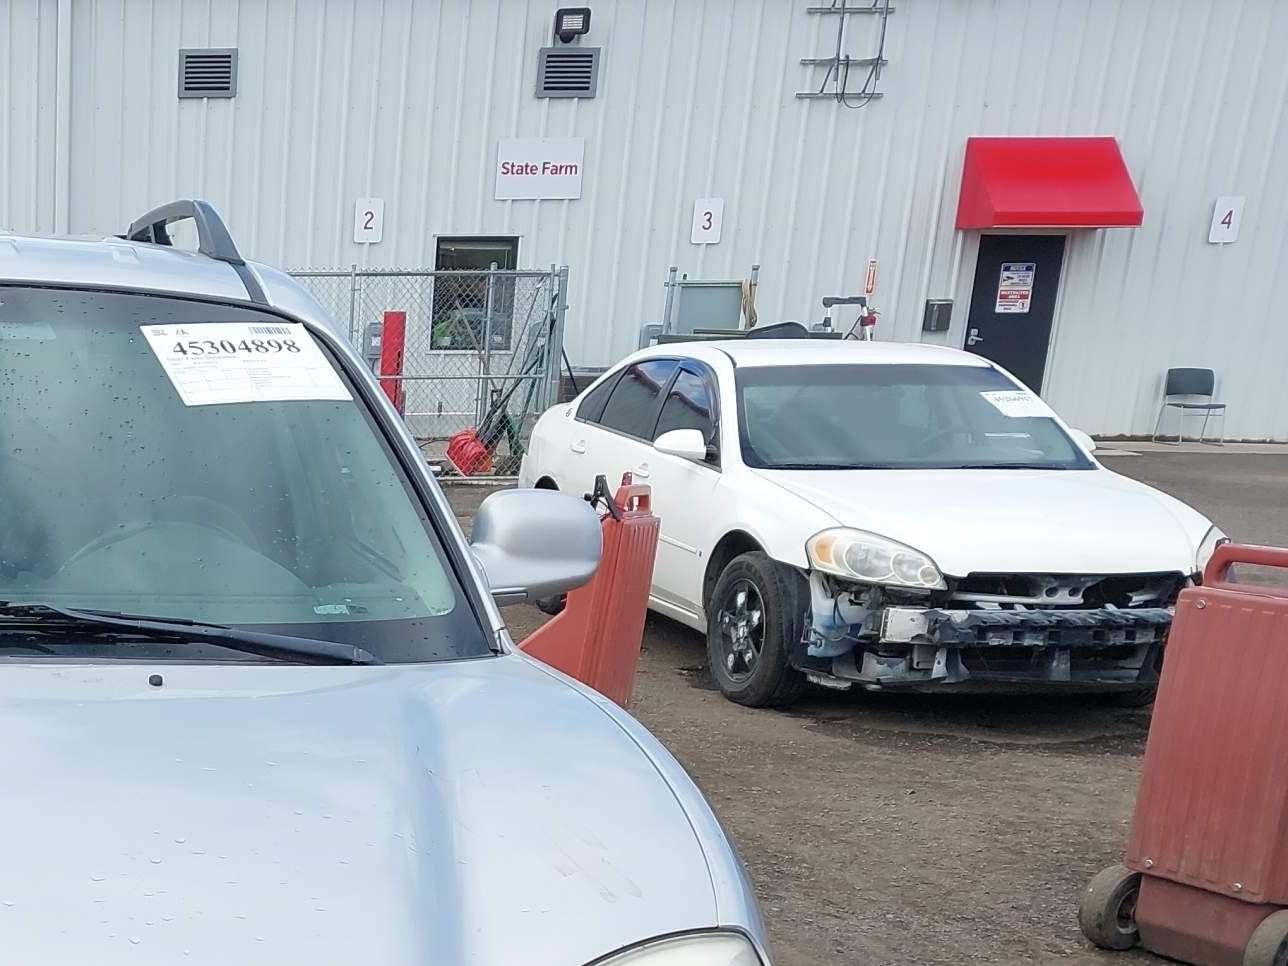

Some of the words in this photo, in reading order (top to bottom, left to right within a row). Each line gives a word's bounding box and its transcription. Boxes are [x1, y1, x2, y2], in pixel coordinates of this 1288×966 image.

[501, 161, 539, 176] State
[542, 161, 579, 176] Farm
[363, 211, 375, 230] 2
[702, 211, 714, 230] 3
[1220, 209, 1234, 230] 4
[172, 339, 302, 356] 45304898
